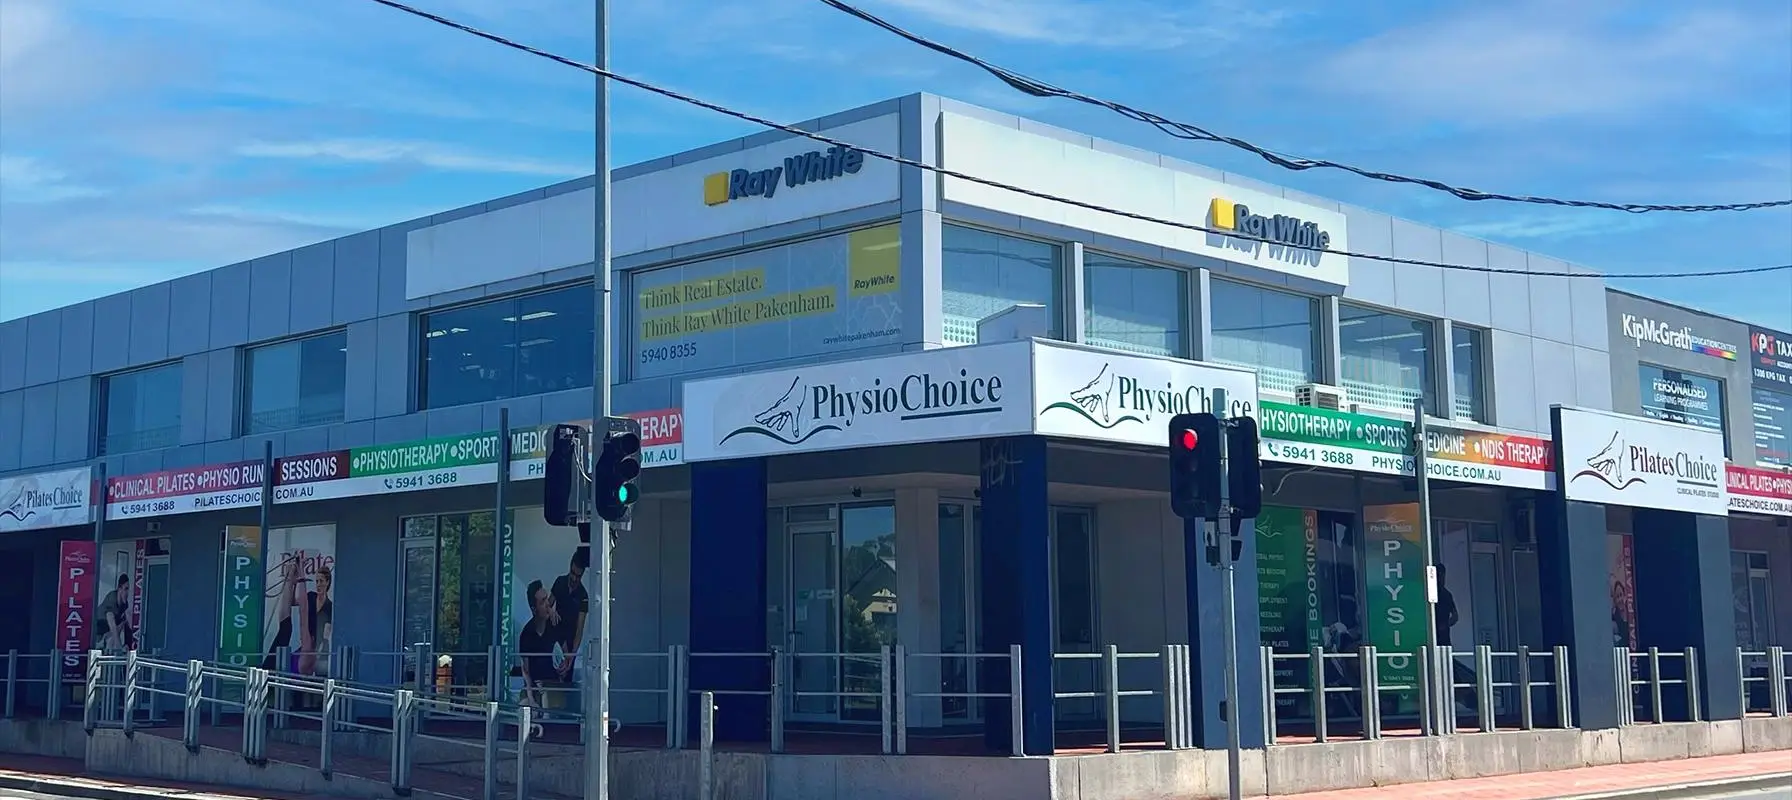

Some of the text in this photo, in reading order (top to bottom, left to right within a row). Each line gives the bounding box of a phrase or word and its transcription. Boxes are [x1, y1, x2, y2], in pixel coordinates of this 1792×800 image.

[729, 146, 864, 200] Ray White
[643, 274, 763, 310] Think Real Estate.
[642, 292, 836, 339] Think Ray White Pakenham.
[641, 341, 698, 364] 5940 8355
[1751, 332, 1792, 358] KPG TAX
[1118, 375, 1252, 421] PhysioChice
[1776, 373, 1787, 383] TAX
[638, 413, 683, 440] ERAPY
[1260, 407, 1549, 466] HYSIOTHERAPY SPORTS EDICINE NDIS THERAPY
[360, 430, 548, 472] PHYSIOTHERAPY SPORT MEDIC
[1282, 445, 1316, 461] 5941
[1321, 452, 1354, 465] 3688
[114, 456, 337, 499] CLINICAL PILATES PHYSIO RUN SESSIONS
[395, 472, 457, 489] 5941 3688
[1727, 470, 1749, 489] LINICAL
[1749, 473, 1773, 493] PILATES
[130, 502, 151, 514] 5941
[152, 500, 175, 512] 3688
[1727, 497, 1792, 512] ATESCHOICE.COM.AU
[133, 548, 145, 614] PILATES
[1305, 515, 1318, 621] BOOKINGS
[65, 568, 85, 666] PILATES
[229, 556, 251, 666] PHYSIO
[1383, 540, 1409, 670] PHYSIO
